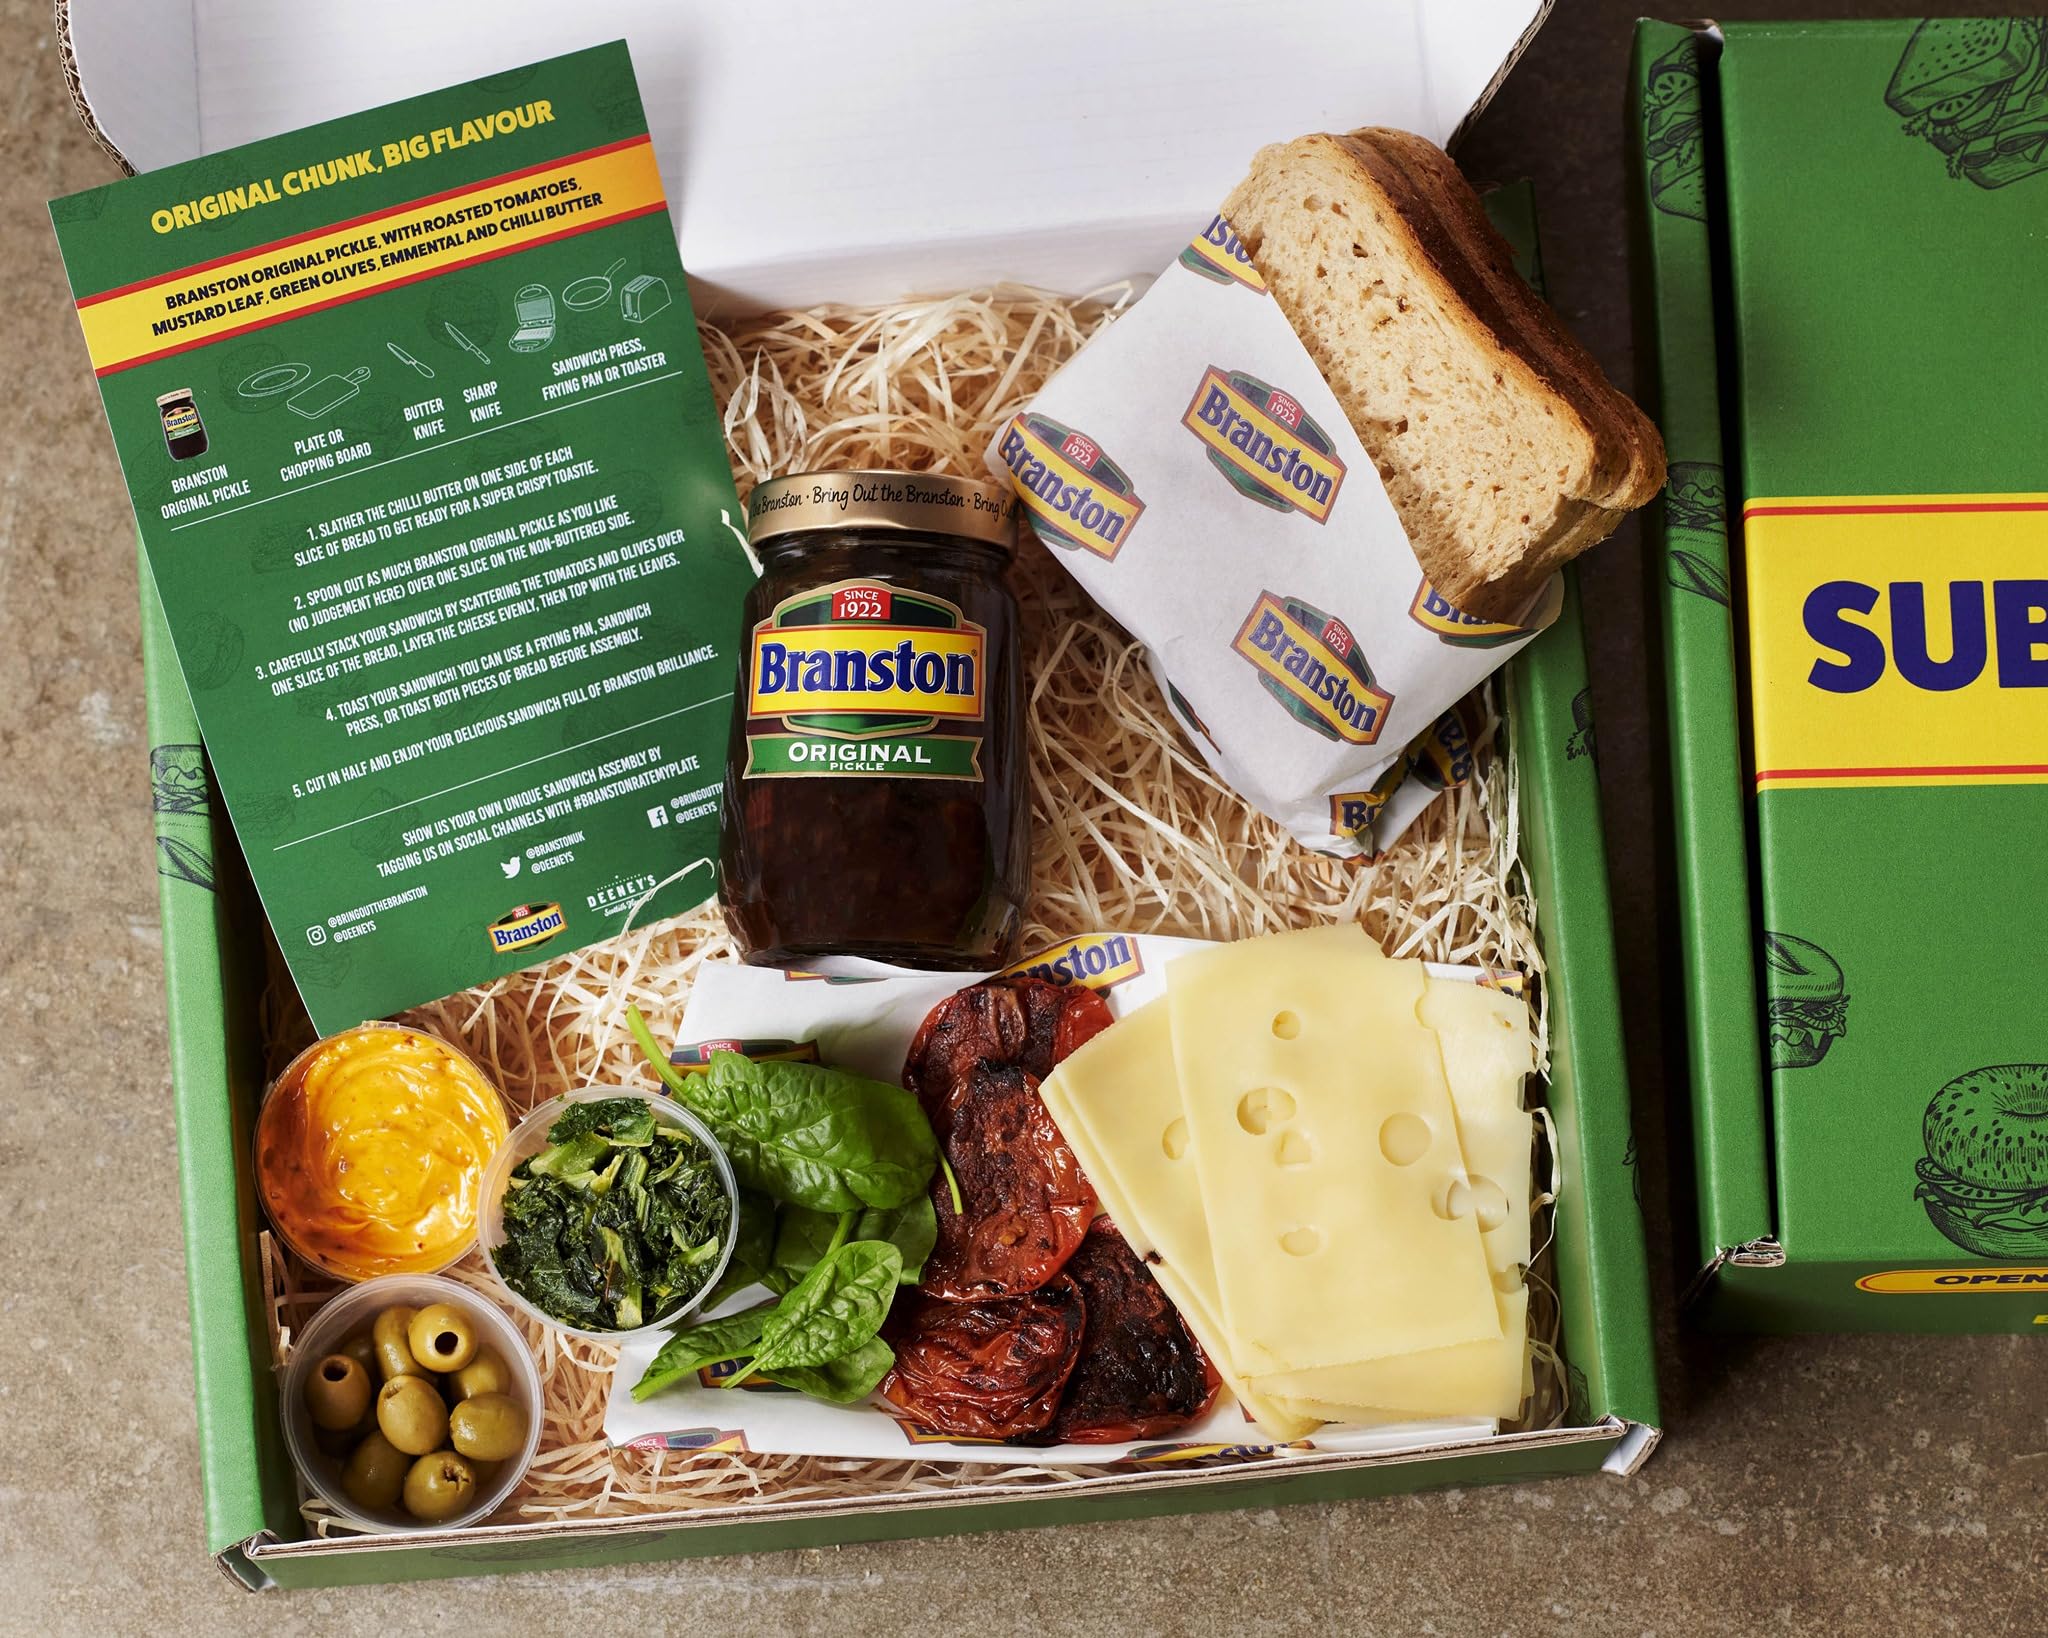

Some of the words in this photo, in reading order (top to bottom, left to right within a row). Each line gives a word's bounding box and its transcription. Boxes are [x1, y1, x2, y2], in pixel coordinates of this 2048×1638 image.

[151, 179, 281, 233] ORIGINAL
[282, 150, 382, 195] CHUNK,
[382, 135, 430, 167] BIG
[430, 100, 555, 154] FLAVOUR
[165, 273, 250, 310] BRANSTON
[251, 252, 325, 283] ORIGINAL
[325, 236, 381, 262] PICKLE,
[381, 222, 422, 245] WITH
[423, 203, 493, 233] ROASTED
[493, 178, 582, 212] TOMATOES,
[152, 303, 226, 336] MUSTARD
[227, 291, 269, 313] LEAF,
[270, 275, 321, 300] GREEN
[322, 258, 380, 284] OLIVES,
[380, 233, 464, 268] EMMENTAL
[466, 223, 498, 243] AND
[500, 209, 545, 232] CHILLI
[545, 192, 603, 219] BUTTER
[552, 347, 608, 376] SANDWICH
[608, 337, 646, 359] PRESS,
[463, 381, 498, 403] SHARP
[542, 378, 580, 401] FRYING
[581, 370, 603, 389] PAN
[604, 366, 621, 382] OR
[619, 352, 667, 377] TOASTER
[166, 412, 197, 428] Branston
[403, 397, 444, 421] BUTTER
[469, 401, 502, 423] KNIFE
[1271, 403, 1295, 425] 1922
[1277, 395, 1297, 413] SINCE
[294, 433, 327, 456] PLATE
[328, 428, 344, 445] OR
[413, 418, 446, 441] KNIFE
[1074, 437, 1095, 454] SINCE
[1197, 383, 1334, 505] Branston
[280, 453, 335, 482] CHOPPING
[335, 442, 372, 464] BOARD
[1065, 443, 1091, 466] 1922
[171, 464, 228, 494] BRANSTON
[306, 527, 318, 541] 1.
[318, 512, 365, 537] SLATHER
[364, 504, 387, 522] THE
[387, 493, 422, 516] CHILLI
[422, 481, 463, 505] BUTTER
[463, 475, 480, 492] ON
[480, 467, 504, 486] ONE
[503, 459, 529, 479] SIDE
[529, 455, 543, 471] OF
[544, 446, 573, 466] EACH
[1002, 427, 1126, 543] Branston
[161, 492, 213, 519] ORIGINAL
[212, 479, 251, 503] PICKLE
[294, 545, 325, 567] SLICE
[325, 540, 339, 557] OF
[341, 529, 377, 552] BREAD
[376, 524, 392, 540] TO
[393, 517, 413, 535] GET
[414, 505, 448, 528] READY
[449, 499, 472, 517] FOR
[472, 496, 481, 510] A
[480, 485, 516, 508] SUPER
[516, 473, 552, 496] CRISPY
[552, 460, 599, 484] TOASTIE.
[762, 489, 802, 513] Branston
[813, 486, 849, 510] Bring
[853, 483, 878, 502] Out
[881, 484, 903, 502] the
[906, 485, 965, 508] Branston
[974, 492, 1000, 522] Bring
[255, 666, 268, 680] 3.
[268, 644, 325, 676] CAREFULLY
[326, 634, 360, 657] STACK
[358, 625, 389, 645] YOUR
[388, 607, 444, 636] SANDWICH
[444, 601, 458, 618] BY
[459, 581, 521, 613] SCATTERING
[520, 574, 543, 592] THE
[542, 557, 597, 585] TOMATOES
[598, 550, 620, 569] AND
[620, 538, 657, 561] OLIVES
[657, 529, 685, 549] OVER
[839, 602, 882, 618] 1922
[844, 590, 879, 601] SINCE
[271, 677, 295, 696] ONE
[294, 667, 326, 689] SLICE
[325, 662, 339, 678] OF
[339, 654, 363, 673] THE
[362, 643, 402, 666] BREAD,
[402, 631, 436, 653] LAYER
[434, 623, 457, 642] THE
[457, 610, 498, 635] CHEESE
[497, 597, 540, 622] EVENLY,
[538, 587, 568, 608] THEN
[567, 581, 588, 599] TOP
[588, 571, 617, 592] WITH
[616, 565, 639, 583] THE
[638, 552, 680, 576] LEAVES.
[1333, 623, 1348, 642] SINCE
[1326, 630, 1346, 654] 1922
[758, 640, 976, 697] Branston
[1248, 608, 1377, 732] Branston
[292, 783, 305, 798] 5.
[305, 774, 326, 794] CUT
[326, 770, 341, 787] IN
[340, 761, 367, 782] HALF
[369, 753, 392, 773] AND
[392, 741, 425, 765] ENJOY
[424, 733, 454, 753] YOUR
[453, 714, 508, 744] DELICIOUS
[506, 696, 562, 726] SANDWICH
[561, 688, 588, 707] FULL
[587, 682, 601, 699] OF
[602, 664, 656, 694] BRANSTON
[656, 644, 718, 675] BRILLIANCE.
[788, 742, 932, 764] ORIGINAL
[829, 762, 885, 771] PICKLE
[402, 824, 433, 847] SHOW
[434, 819, 450, 836] US
[448, 810, 478, 830] YOUR
[477, 800, 504, 820] OWN
[503, 787, 543, 812] UNIQUE
[542, 768, 597, 799] SANDWICH
[598, 751, 647, 780] ASSEMBLY
[647, 746, 661, 762] BY
[675, 801, 718, 824] @DEENEYS
[376, 851, 422, 878] TAGGING
[422, 845, 438, 862] US
[437, 840, 454, 857] ON
[453, 828, 492, 851] SOCIAL
[491, 808, 545, 838] CHANNELS
[543, 799, 573, 819] WITH
[573, 755, 700, 810] #BRANSTONRATEMYPLATE
[526, 830, 586, 859] @BRANSTONUK
[531, 851, 574, 874] @DEENEYS
[328, 885, 428, 928] @BRINGOUTTHEBRANSTON
[587, 875, 656, 908] DEENEY'S
[333, 920, 377, 943] @DEENEYS
[493, 911, 562, 946] Branston
[1005, 935, 1132, 987] nston
[707, 1043, 732, 1051] SINCE
